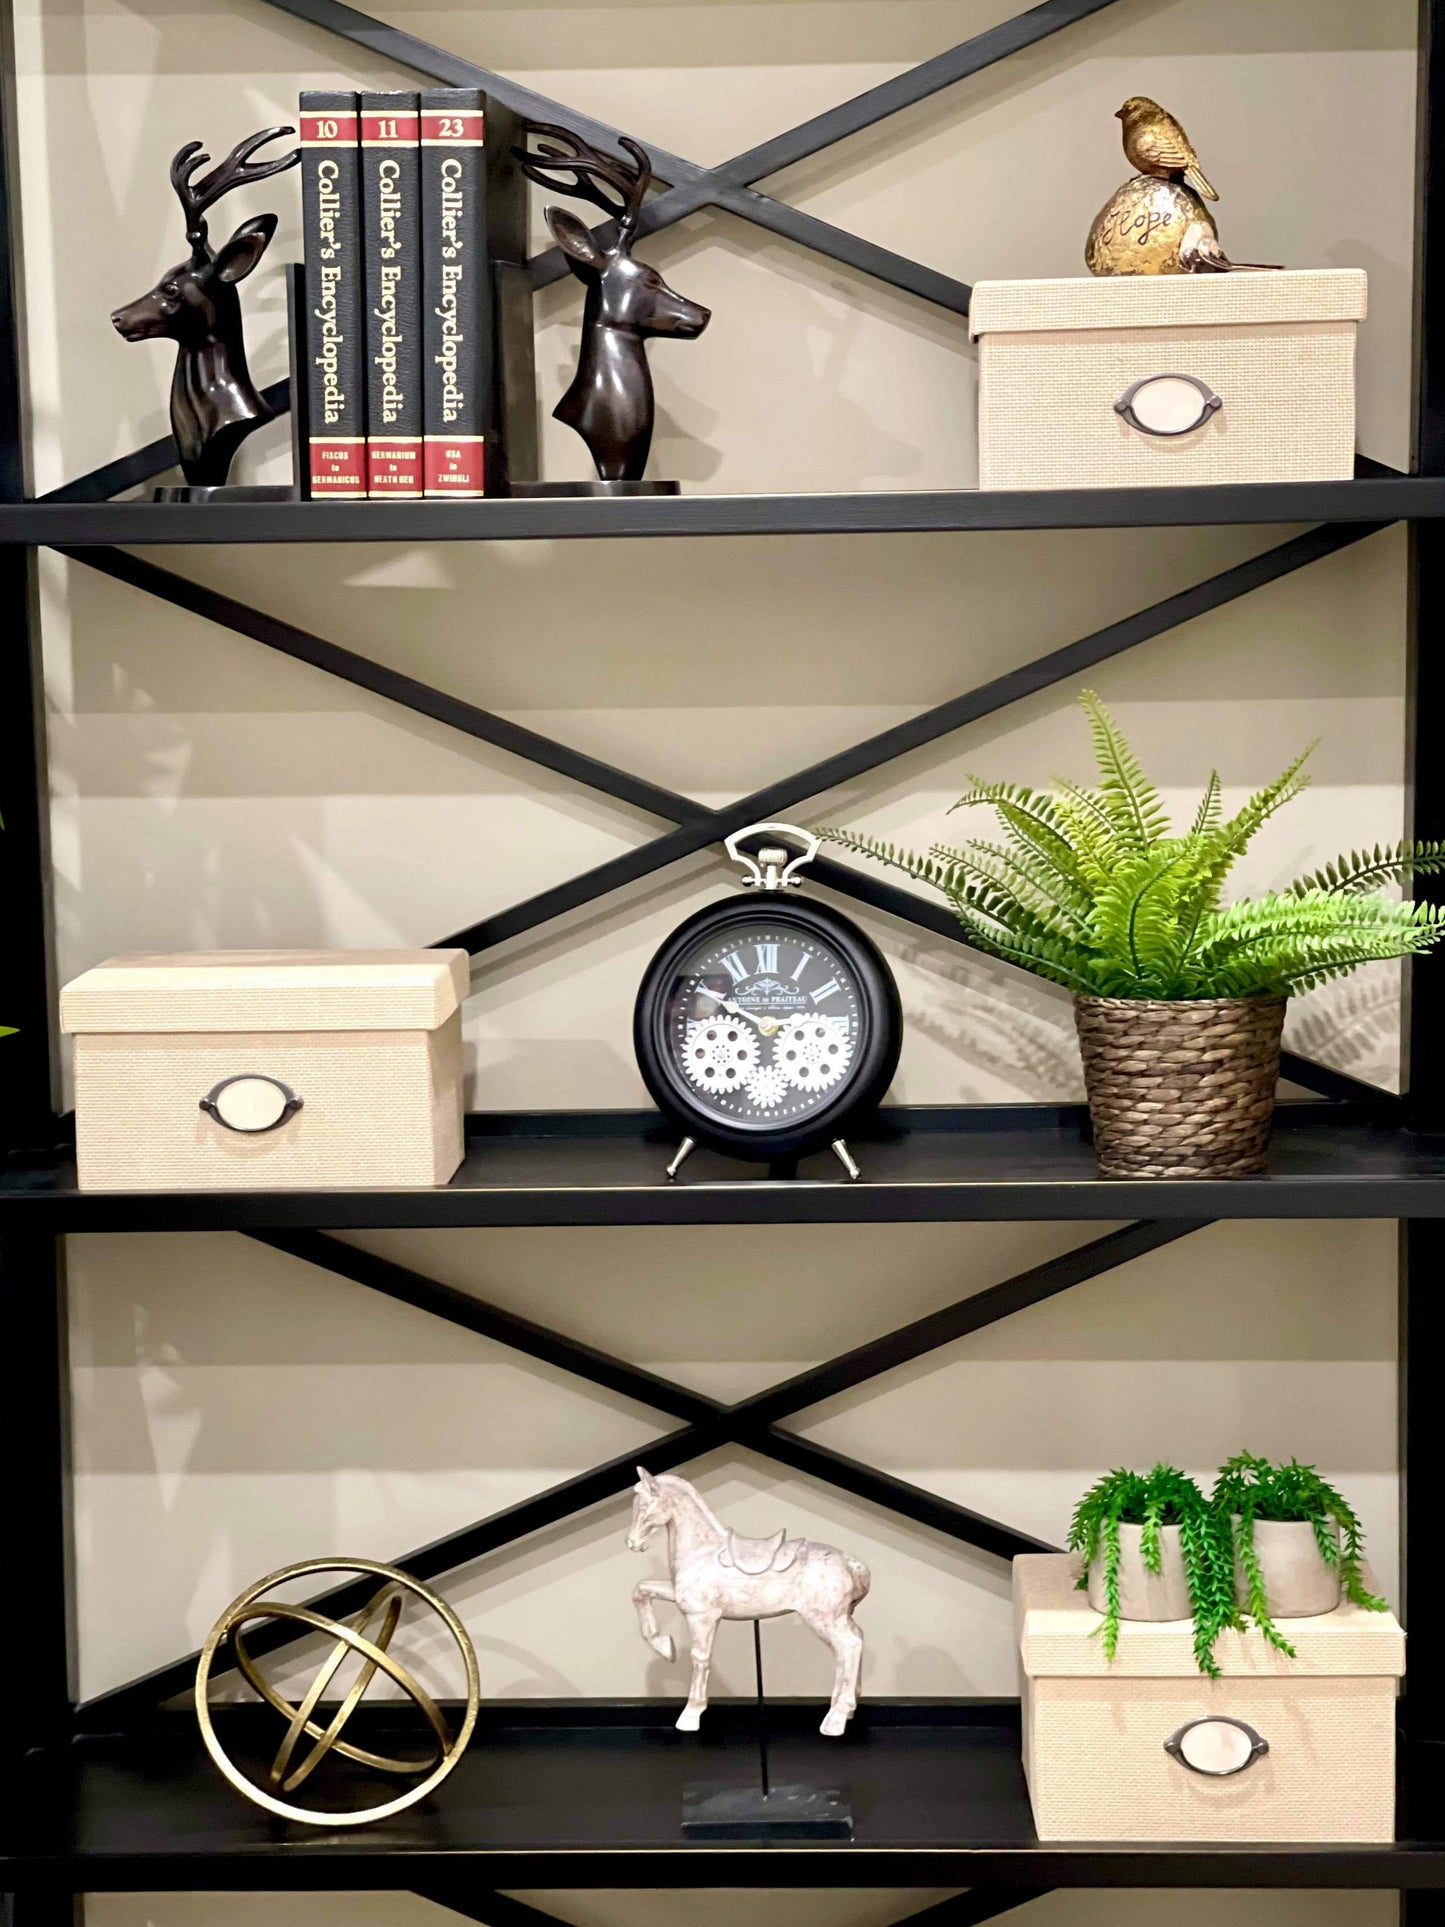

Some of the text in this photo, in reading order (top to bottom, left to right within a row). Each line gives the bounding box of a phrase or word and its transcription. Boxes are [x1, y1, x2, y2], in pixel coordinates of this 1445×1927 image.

[316, 120, 338, 138] 10
[378, 120, 399, 138] 11
[438, 119, 464, 137] 23
[1102, 210, 1172, 246] Hope
[314, 159, 346, 425] Collier's Encyclopedia
[373, 159, 404, 424] Collier's Encyclopedia
[434, 158, 464, 423] Collier's Encyclopedia
[331, 463, 340, 472] to
[388, 463, 397, 472] to
[449, 462, 458, 471] to
